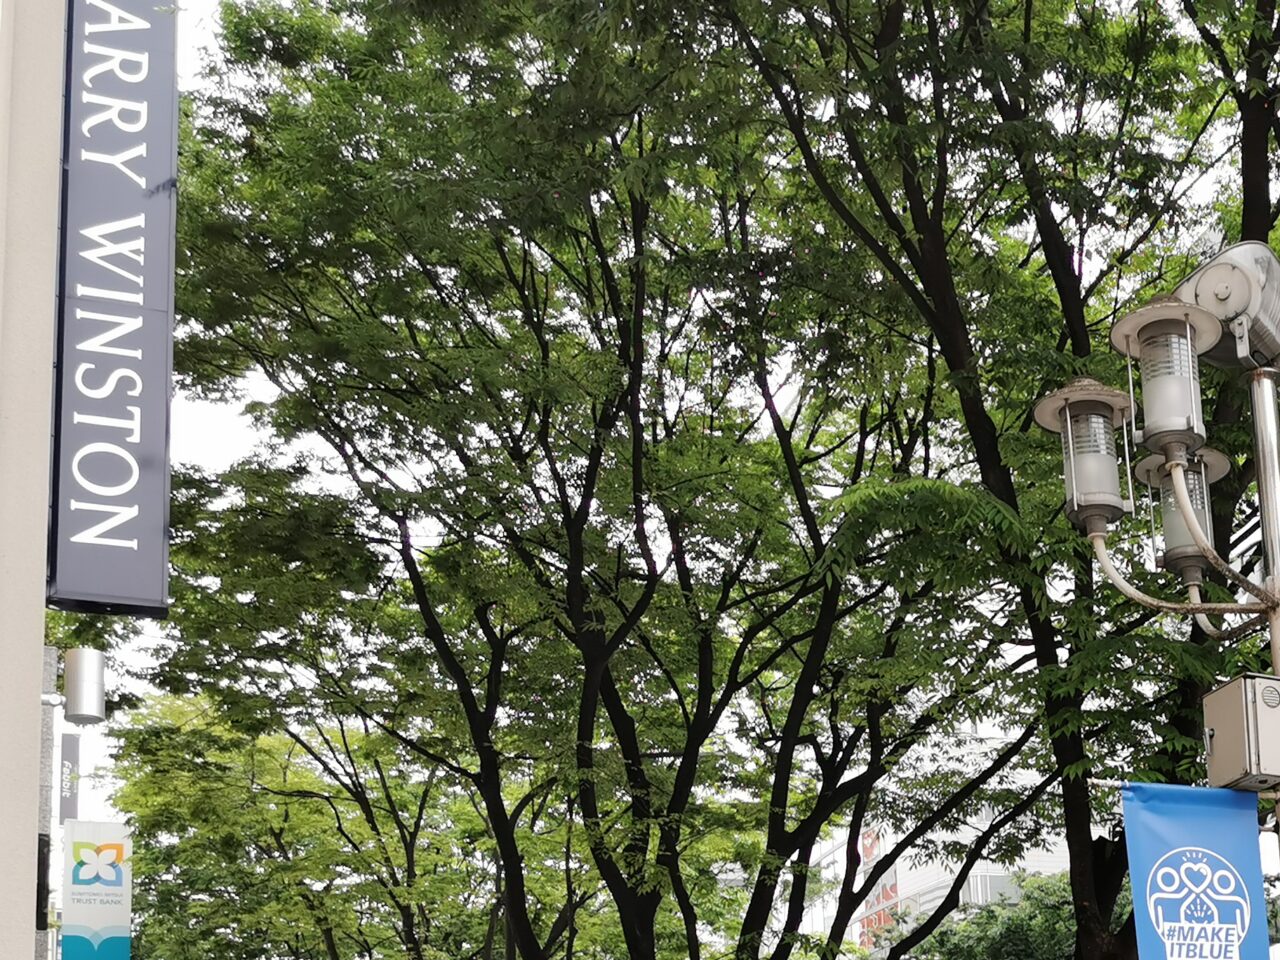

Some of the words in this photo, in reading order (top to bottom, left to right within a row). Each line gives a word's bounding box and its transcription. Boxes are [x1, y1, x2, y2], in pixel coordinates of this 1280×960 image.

[69, 212, 146, 551] WINSTON
[1166, 925, 1237, 944] #MAKE
[1169, 942, 1235, 960] ITBLUE
